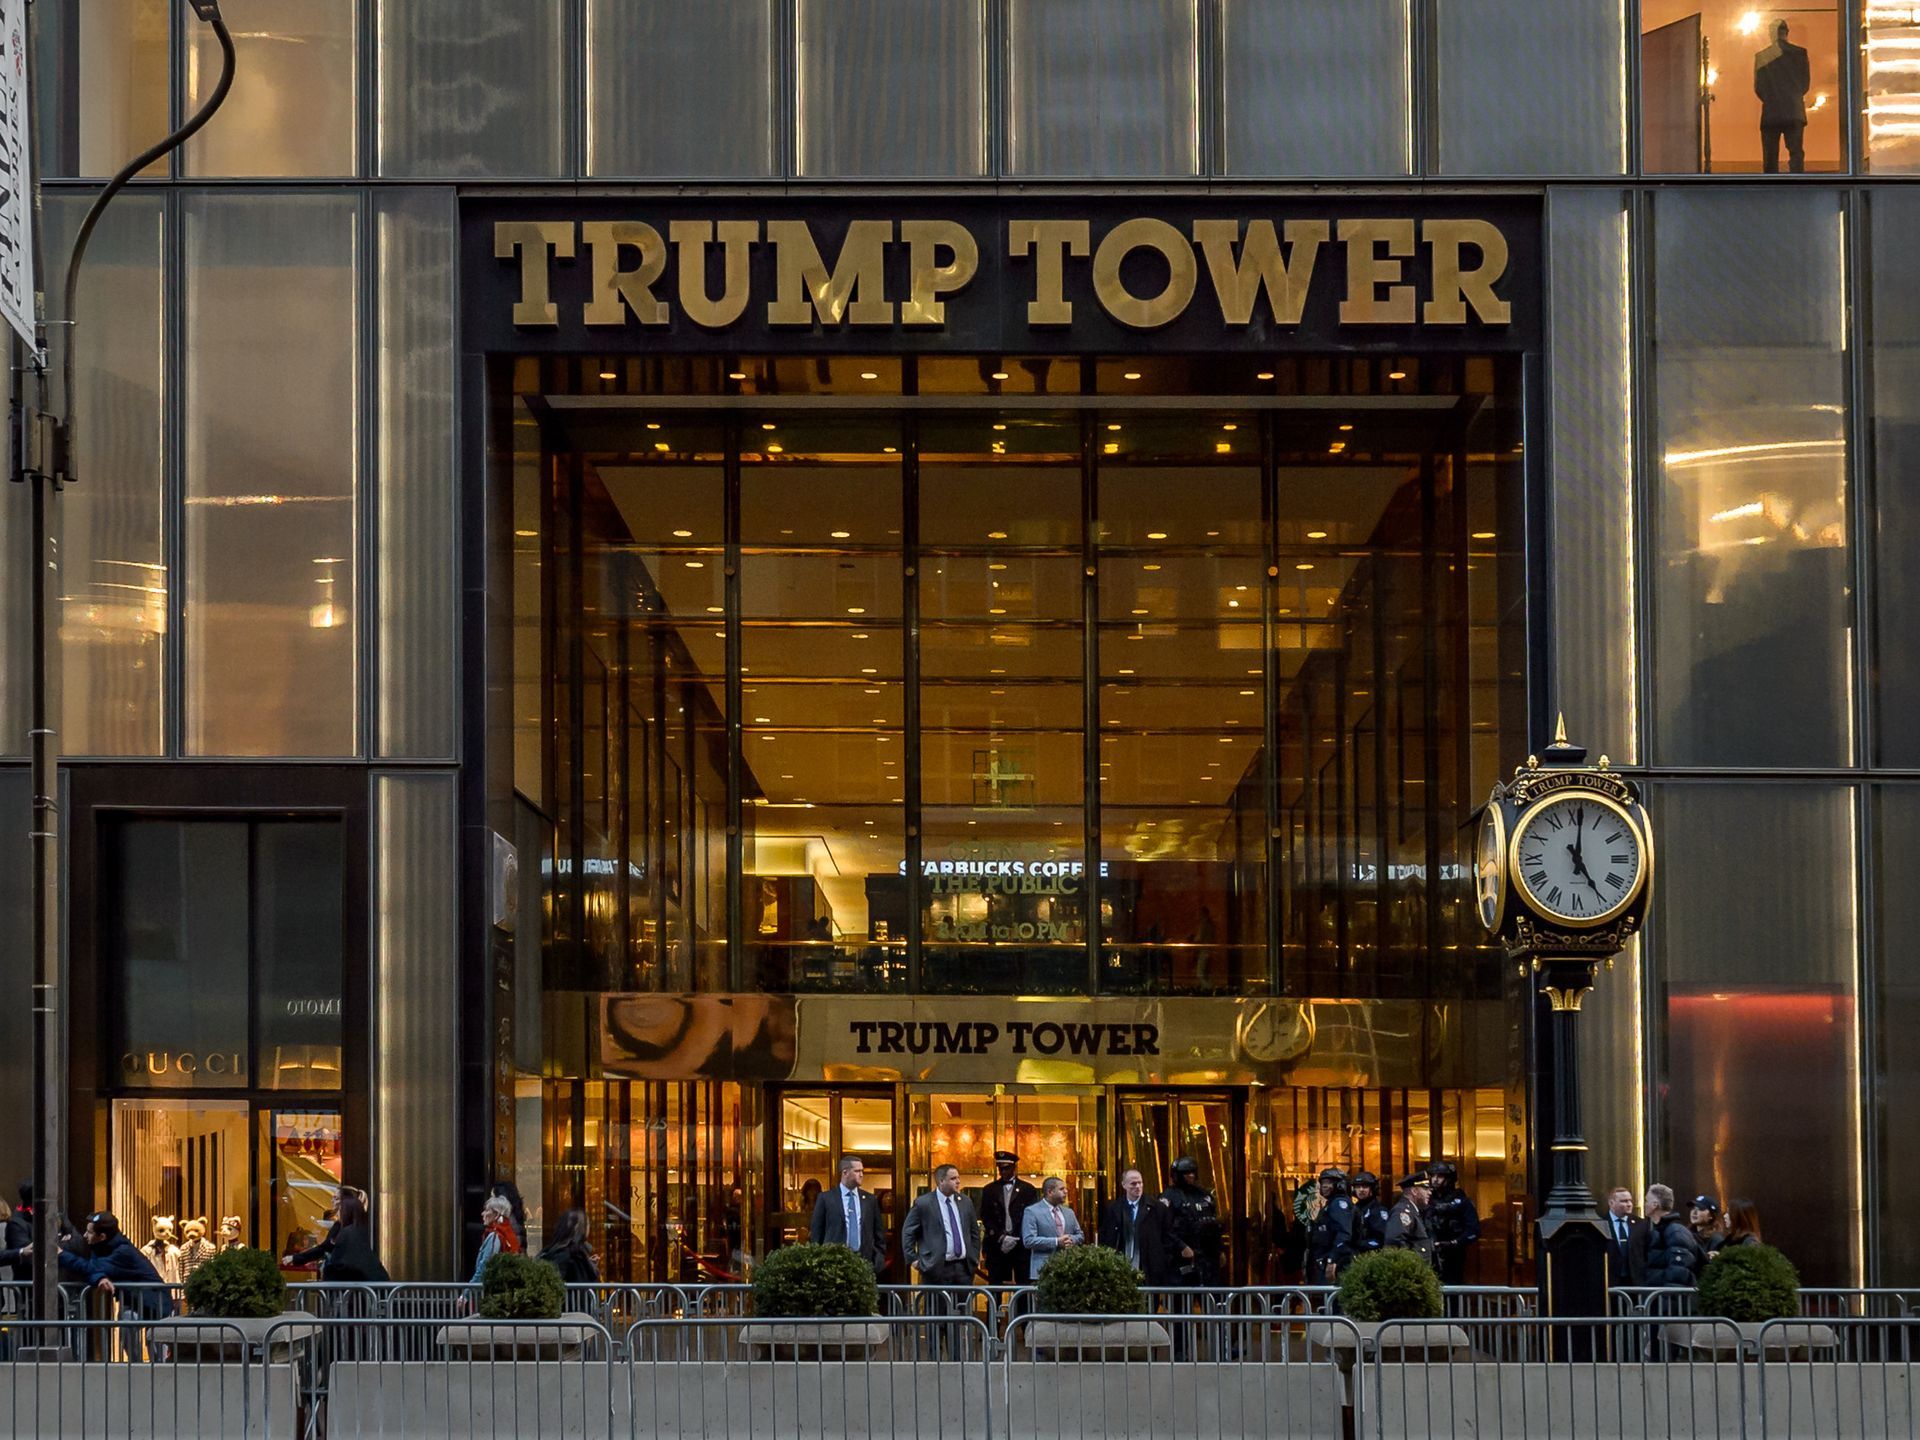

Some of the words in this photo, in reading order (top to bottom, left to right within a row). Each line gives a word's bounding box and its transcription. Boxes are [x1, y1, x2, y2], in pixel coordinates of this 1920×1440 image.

[494, 219, 979, 327] TRUMP
[1009, 217, 1511, 327] TOWER
[1531, 775, 1572, 796] TRUMP
[1577, 775, 1619, 795] TOWER
[899, 861, 1025, 876] SARBUCKS
[928, 874, 981, 894] THE
[985, 874, 1079, 894] PUBLIC
[850, 1021, 999, 1055] TRUMP
[1006, 1021, 1160, 1056] TOWER
